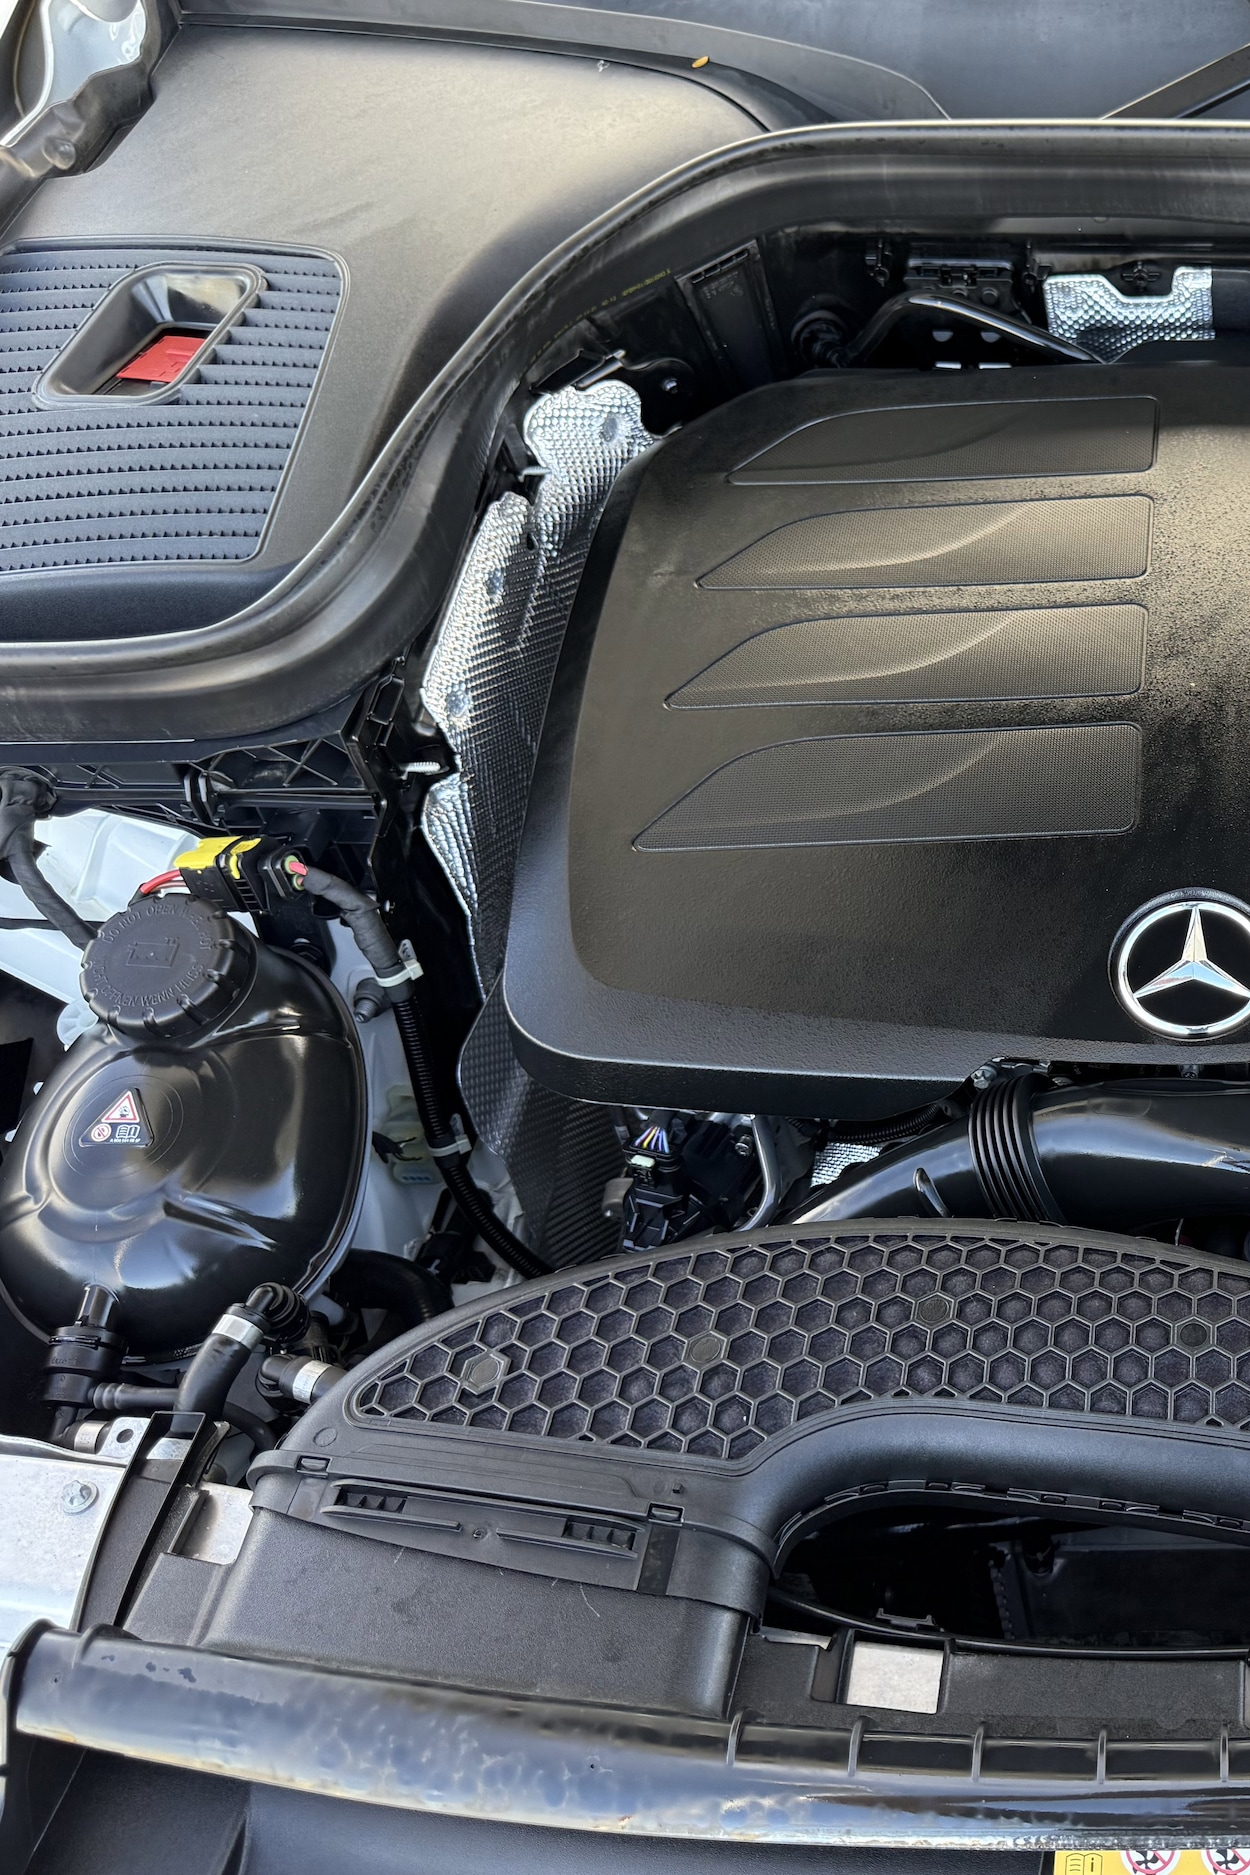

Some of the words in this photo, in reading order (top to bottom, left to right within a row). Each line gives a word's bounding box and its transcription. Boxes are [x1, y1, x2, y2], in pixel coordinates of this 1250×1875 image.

[101, 929, 120, 944] DO
[120, 911, 142, 929] NOT
[145, 903, 179, 916] OPEN
[140, 988, 175, 1008] WENN
